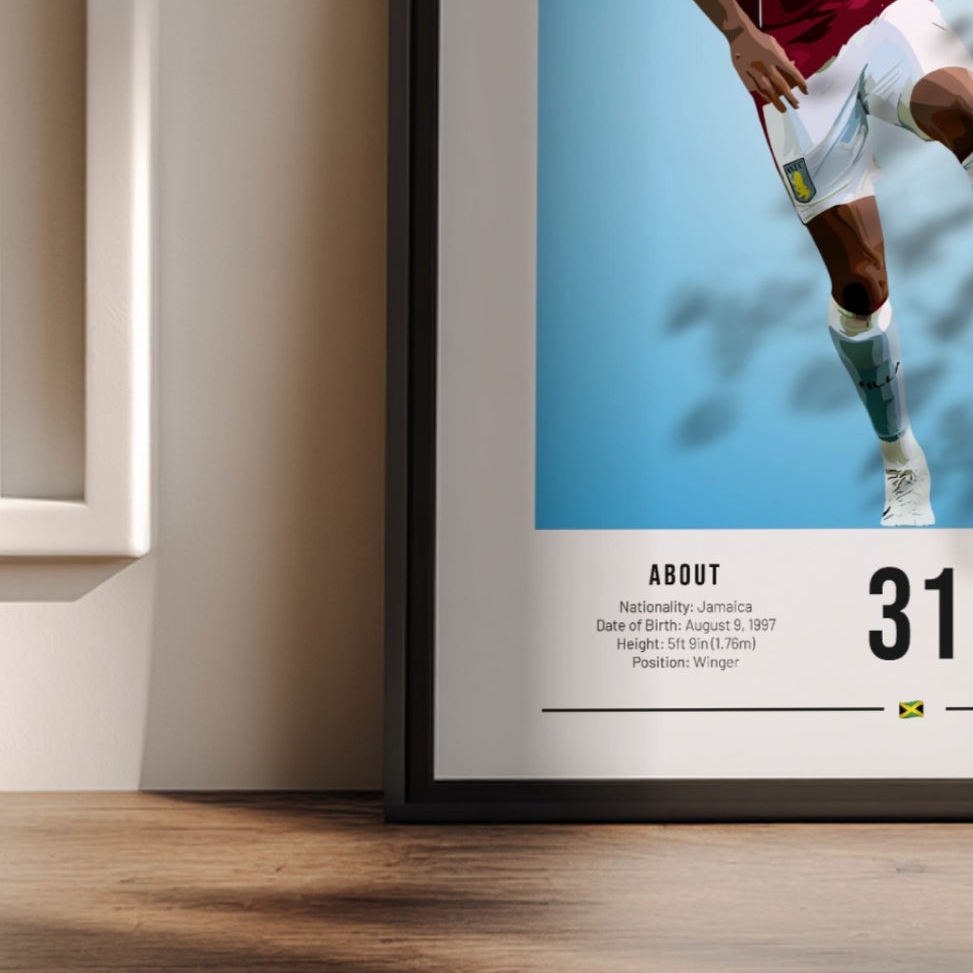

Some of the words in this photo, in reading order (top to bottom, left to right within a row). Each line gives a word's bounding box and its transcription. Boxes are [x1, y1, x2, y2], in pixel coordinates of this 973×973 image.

[648, 563, 721, 586] ABOUT
[619, 600, 694, 616] Nationality:
[697, 600, 753, 614] Jamaica
[868, 566, 954, 661] 31
[596, 618, 626, 632] Date
[628, 618, 642, 632] of
[645, 618, 682, 632] Birth:
[685, 618, 731, 635] August
[733, 618, 745, 634] 9,
[749, 618, 777, 632] 1997
[617, 637, 665, 653] Height:
[667, 636, 686, 651] 5ft
[632, 655, 690, 669] Position:
[693, 655, 740, 671] Winger
